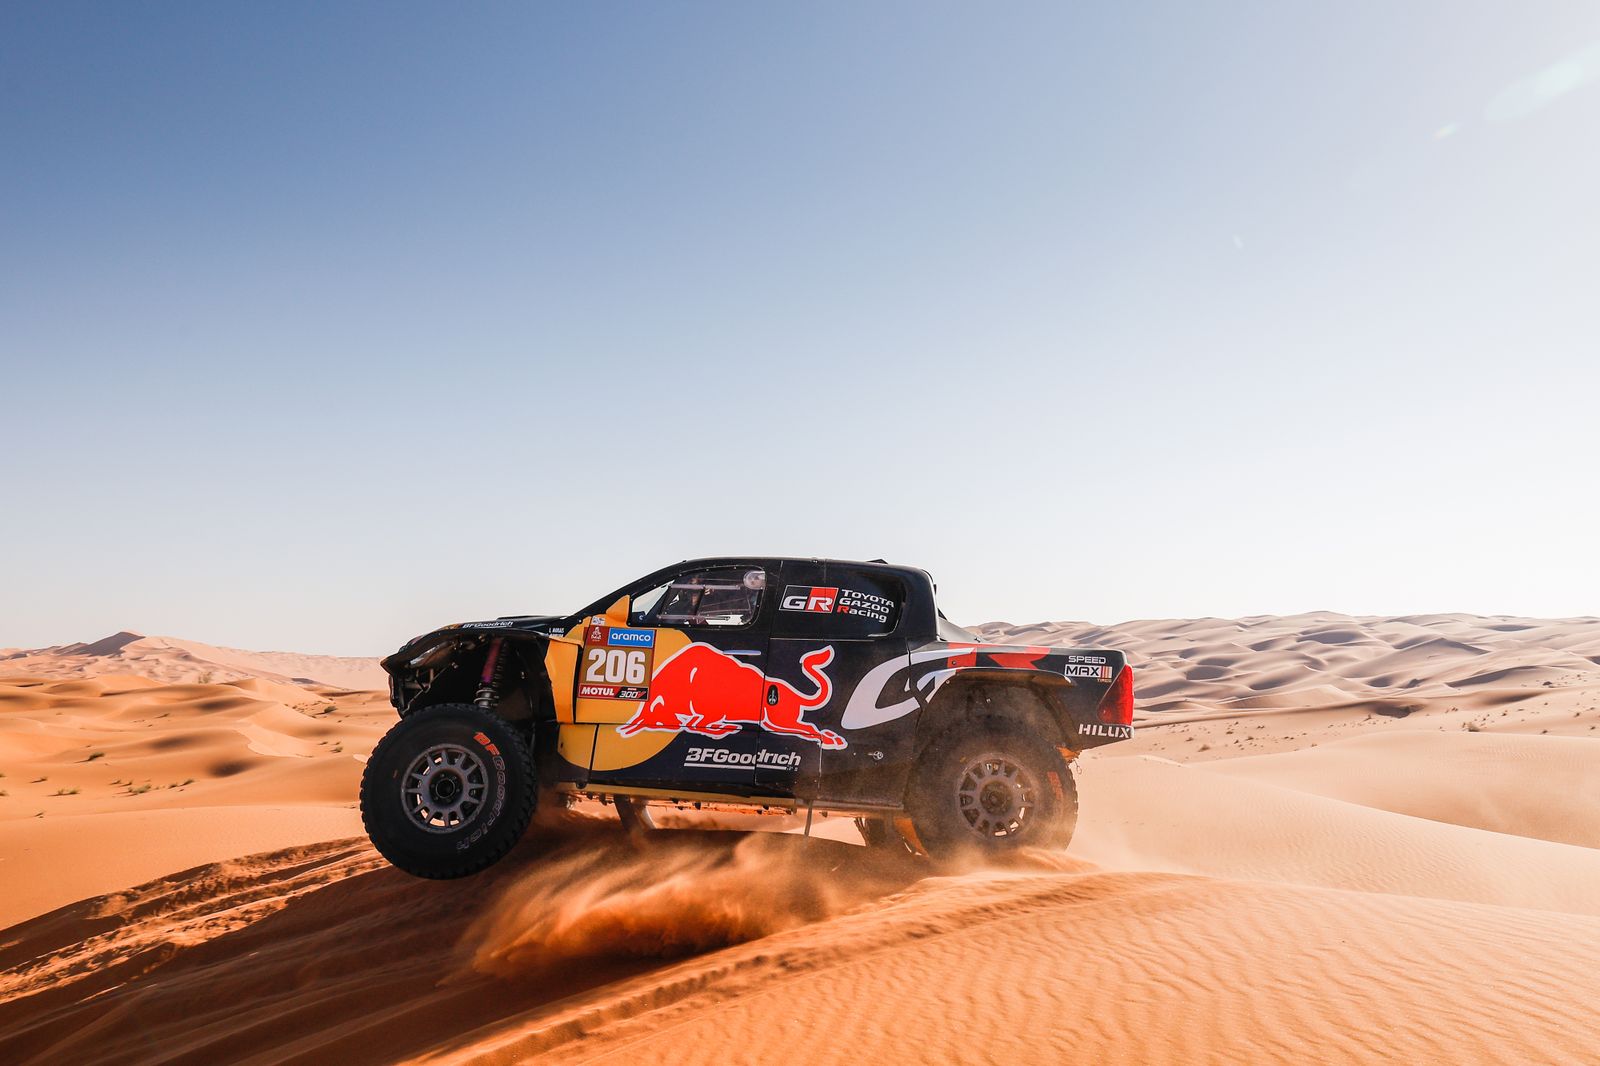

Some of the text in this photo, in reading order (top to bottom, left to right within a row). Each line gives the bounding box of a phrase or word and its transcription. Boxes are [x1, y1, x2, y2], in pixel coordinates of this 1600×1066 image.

[782, 595, 833, 612] GR
[838, 597, 890, 614] GAZOO
[841, 589, 895, 608] TOYOTA
[836, 605, 888, 623] Racing
[611, 633, 651, 642] aramco
[585, 648, 646, 685] 206
[1068, 655, 1107, 665] SPEED
[1065, 665, 1100, 677] MAX
[581, 686, 647, 699] MOTUL 300V
[1078, 723, 1131, 739] HILUX
[685, 747, 802, 766] BFGoodrich
